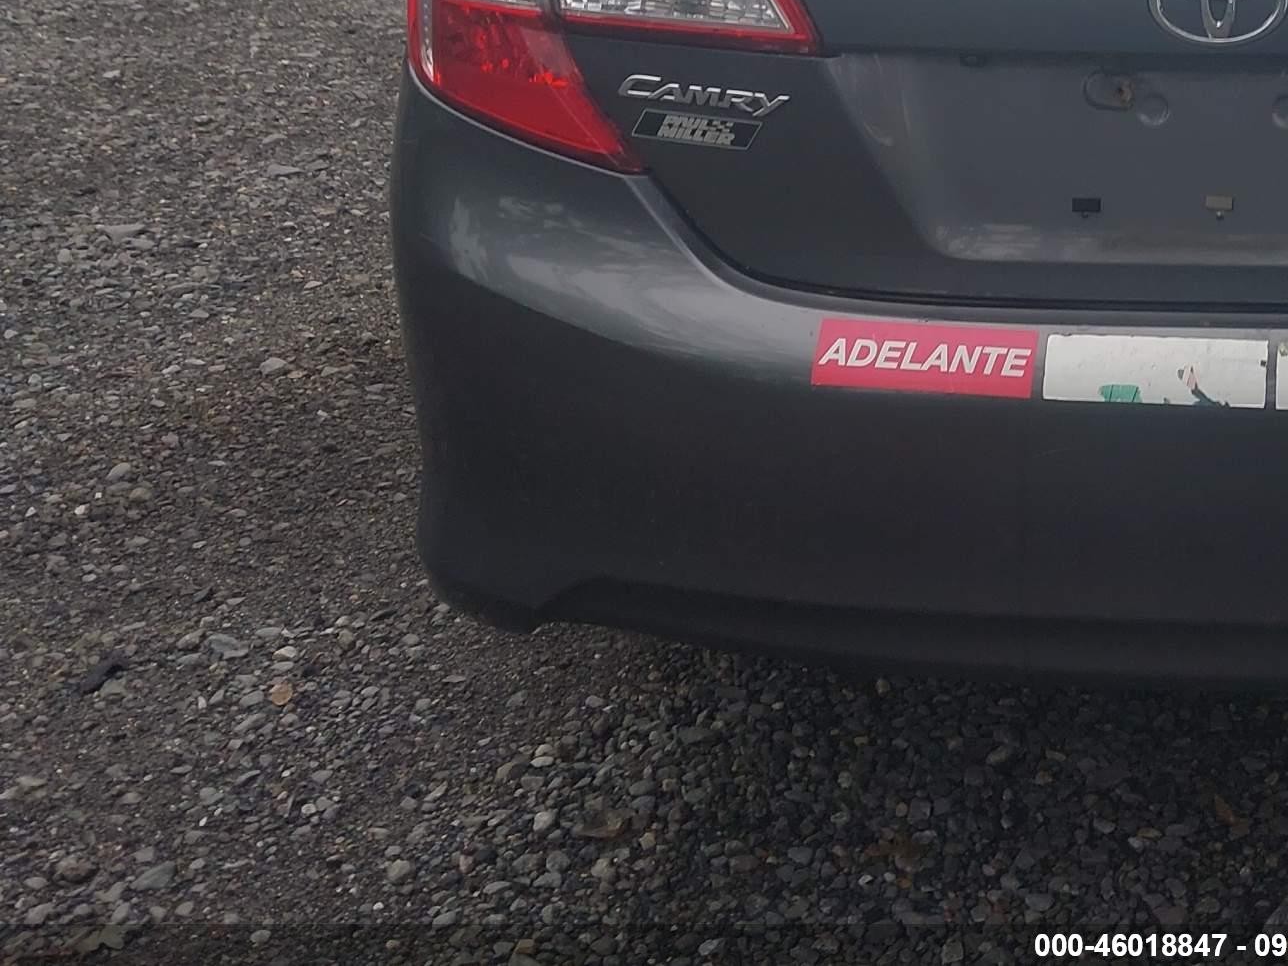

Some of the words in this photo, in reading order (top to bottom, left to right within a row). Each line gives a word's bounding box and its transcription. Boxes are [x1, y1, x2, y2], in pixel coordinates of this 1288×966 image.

[618, 74, 790, 117] CAMRY
[656, 123, 736, 146] MILLER
[818, 337, 1032, 378] ADELANTE
